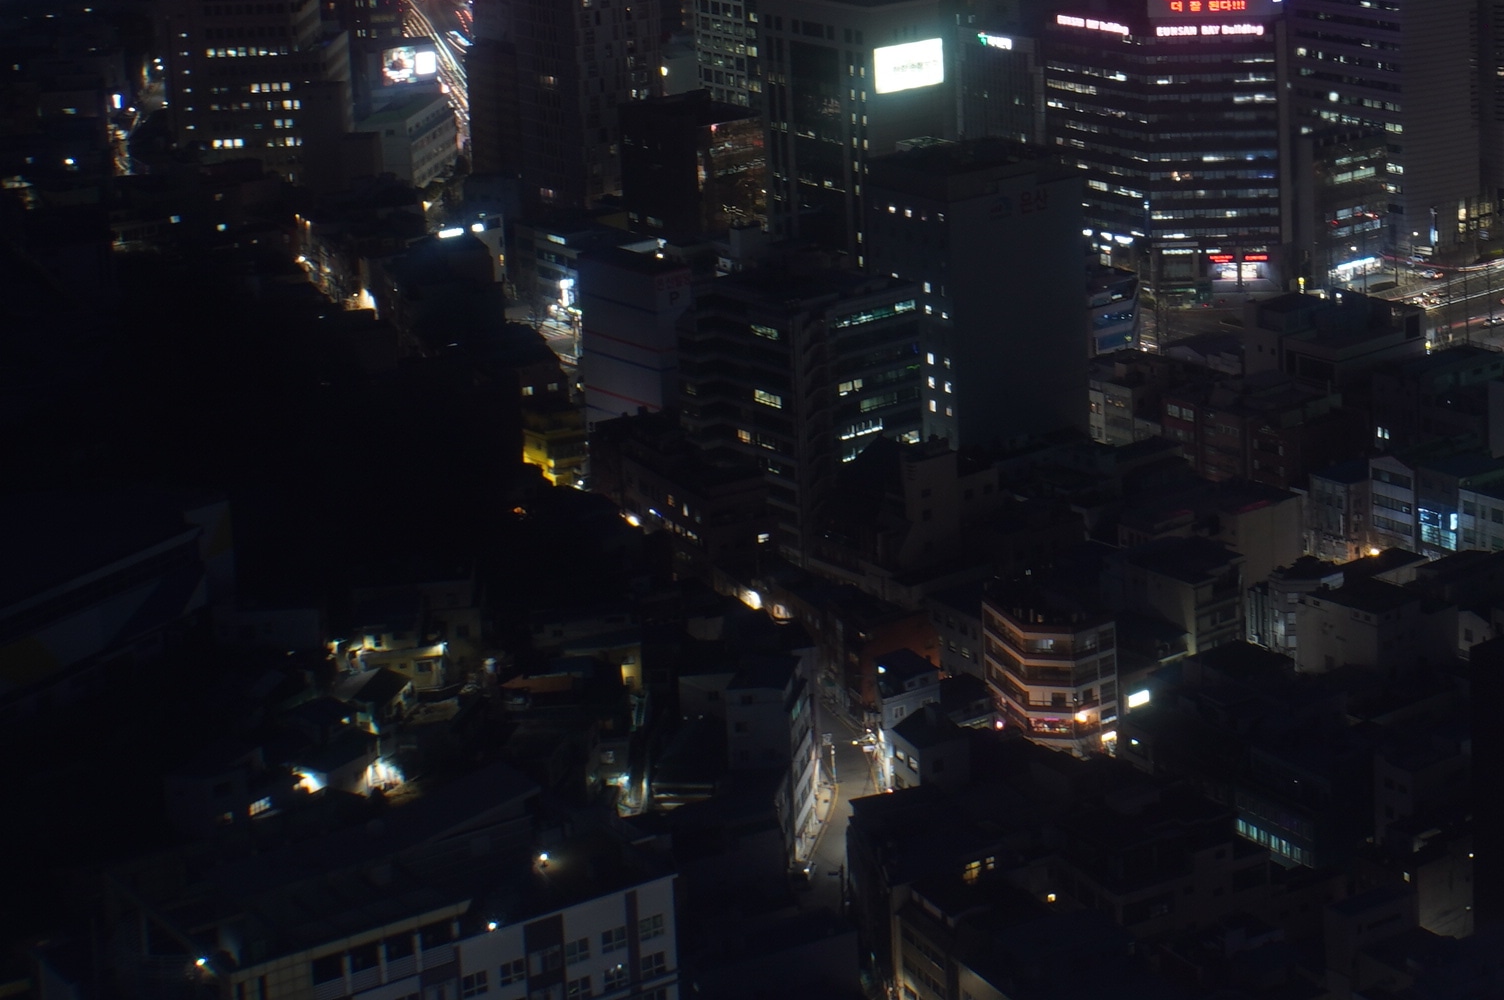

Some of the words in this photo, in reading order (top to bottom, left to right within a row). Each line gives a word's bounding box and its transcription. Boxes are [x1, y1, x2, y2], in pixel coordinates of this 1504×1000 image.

[1201, 25, 1220, 35] BAY
[1221, 24, 1264, 36] Building
[670, 291, 681, 306] P
